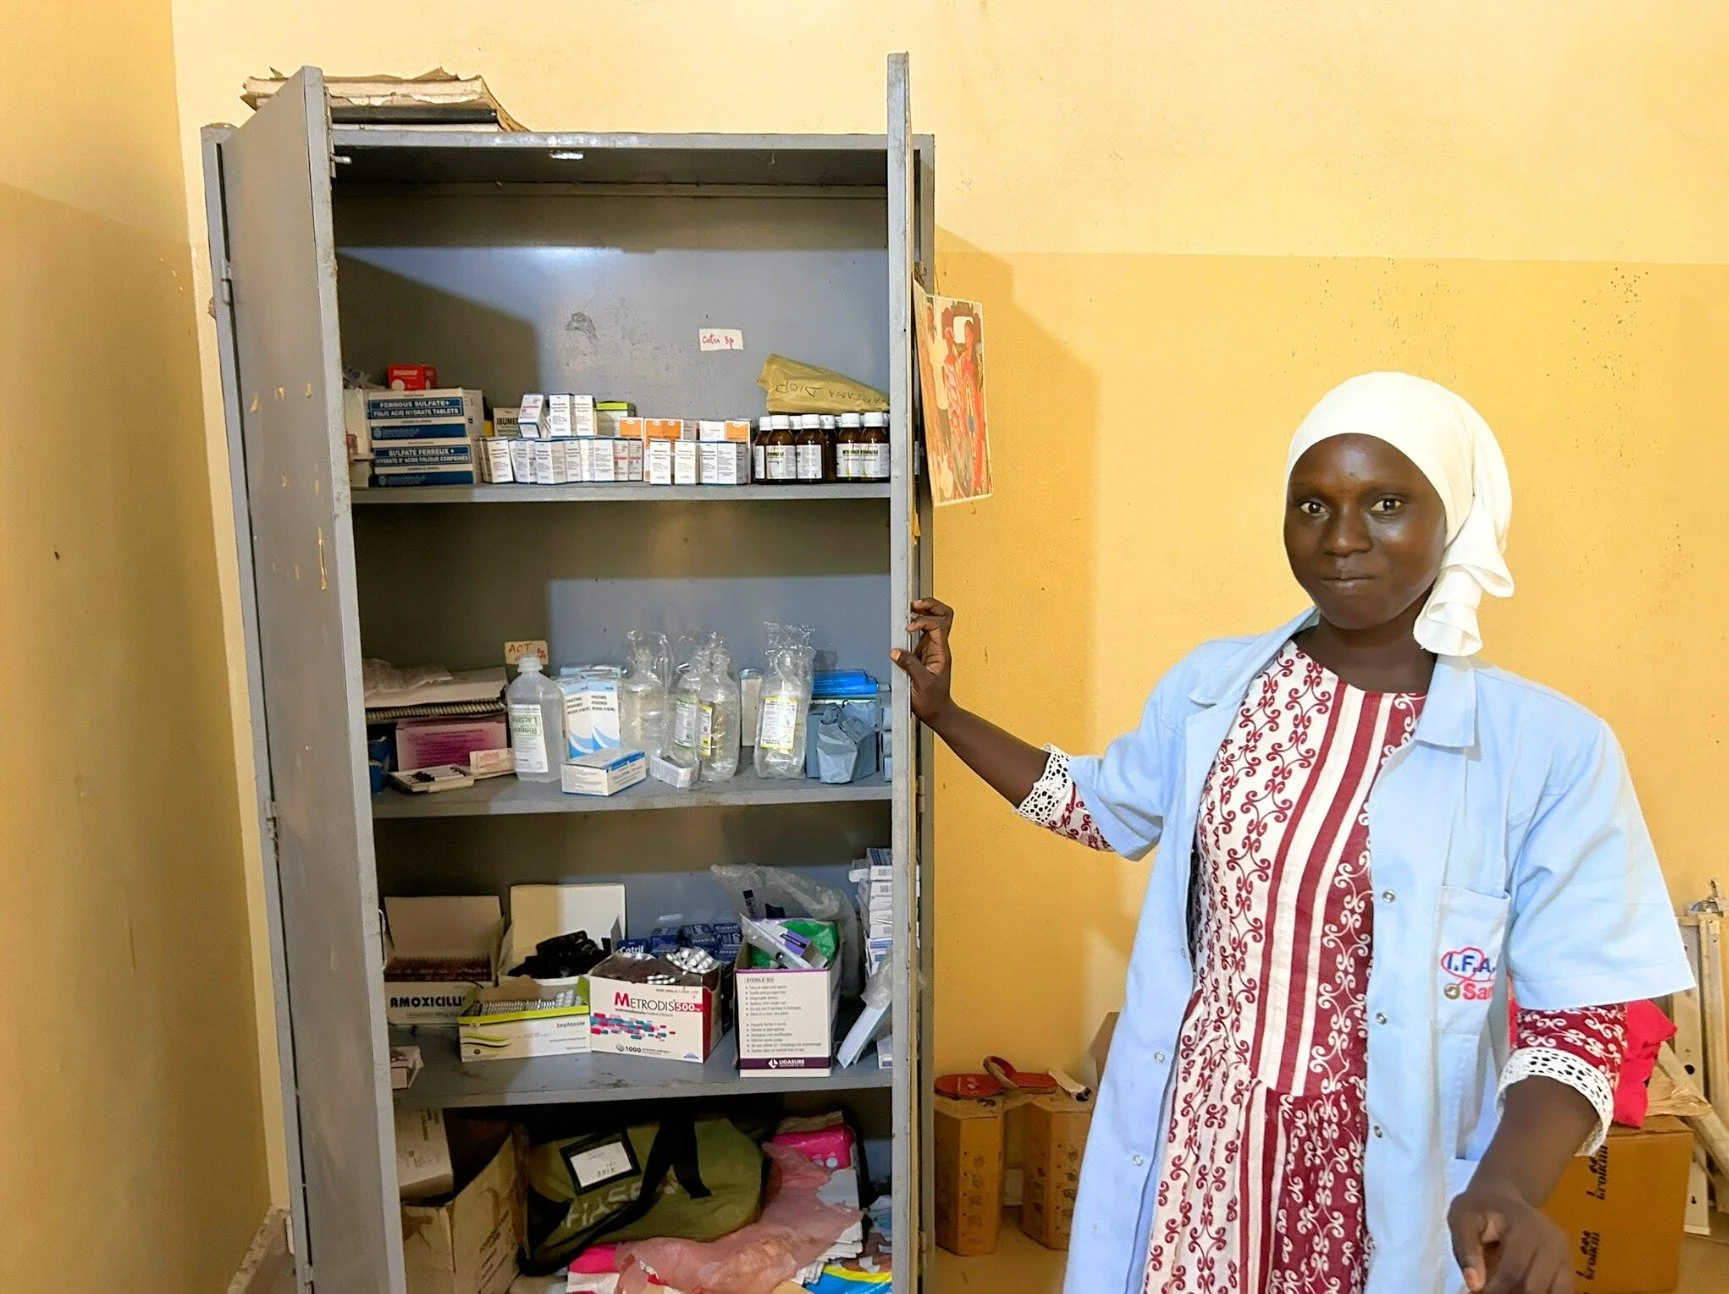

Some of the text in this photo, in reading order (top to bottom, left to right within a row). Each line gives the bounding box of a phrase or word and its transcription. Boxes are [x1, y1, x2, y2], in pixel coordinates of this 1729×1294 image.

[380, 400, 412, 408] FERROUS
[389, 449, 417, 457] SULFATE
[418, 448, 450, 456] FERREUX
[508, 642, 532, 653] ACT
[390, 996, 465, 1008] AMOXICILLI
[614, 991, 675, 1012] METRODIS
